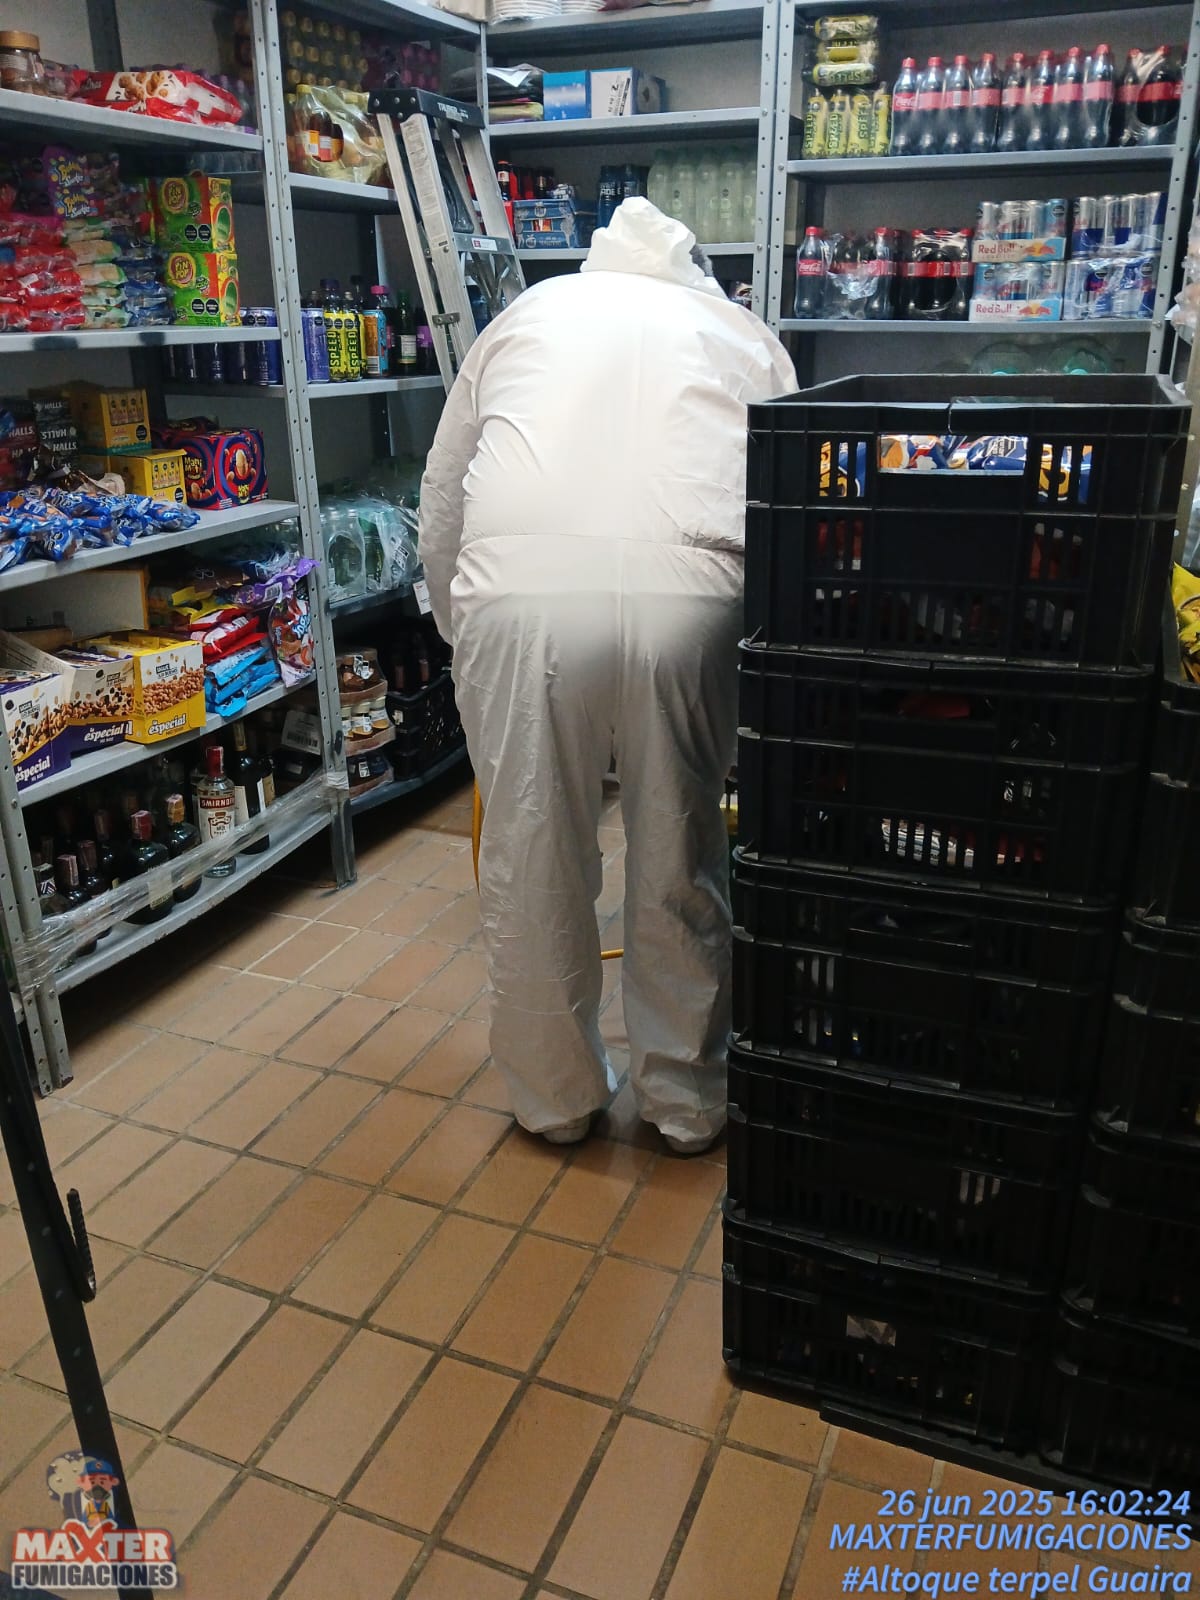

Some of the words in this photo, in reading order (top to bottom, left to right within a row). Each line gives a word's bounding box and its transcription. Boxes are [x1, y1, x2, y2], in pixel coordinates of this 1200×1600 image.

[978, 244, 997, 255] Red
[175, 260, 189, 270] PIN
[175, 269, 190, 280] POP
[976, 304, 995, 314] Red
[327, 331, 340, 368] SPEED
[347, 331, 359, 367] SPEED
[8, 425, 34, 438] HALLS
[41, 428, 67, 440] HALLS
[52, 441, 77, 452] HALLS
[148, 713, 187, 735] especial
[84, 722, 125, 742] especial
[15, 755, 51, 783] especial
